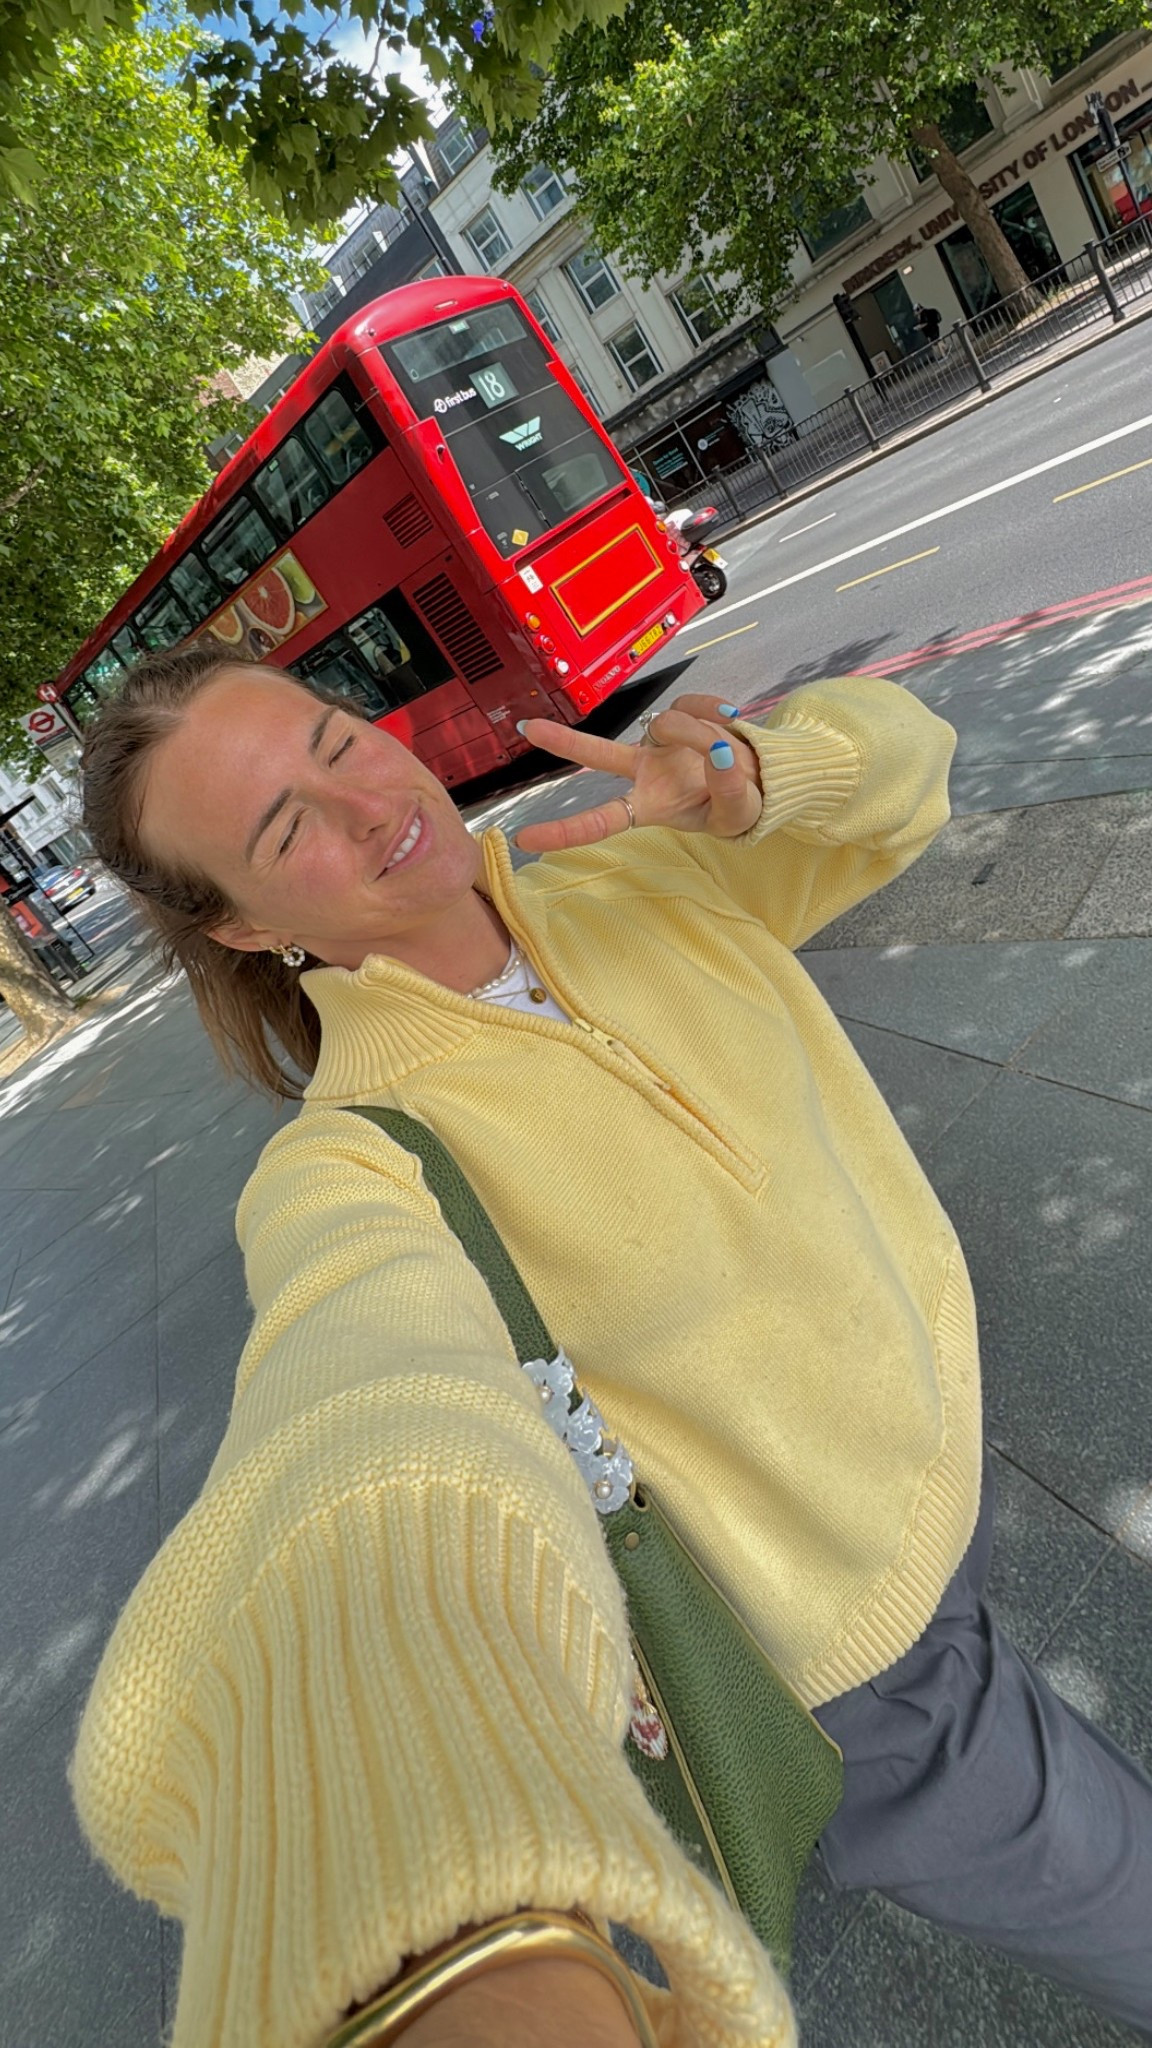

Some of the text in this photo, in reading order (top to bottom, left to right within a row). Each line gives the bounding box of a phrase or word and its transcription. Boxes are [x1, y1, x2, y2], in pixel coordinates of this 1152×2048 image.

[919, 159, 1019, 242] UNIVSITY
[1024, 143, 1048, 169] OF
[1051, 78, 1140, 151] LONON
[478, 371, 506, 401] 18
[515, 433, 542, 450] WRIGHT
